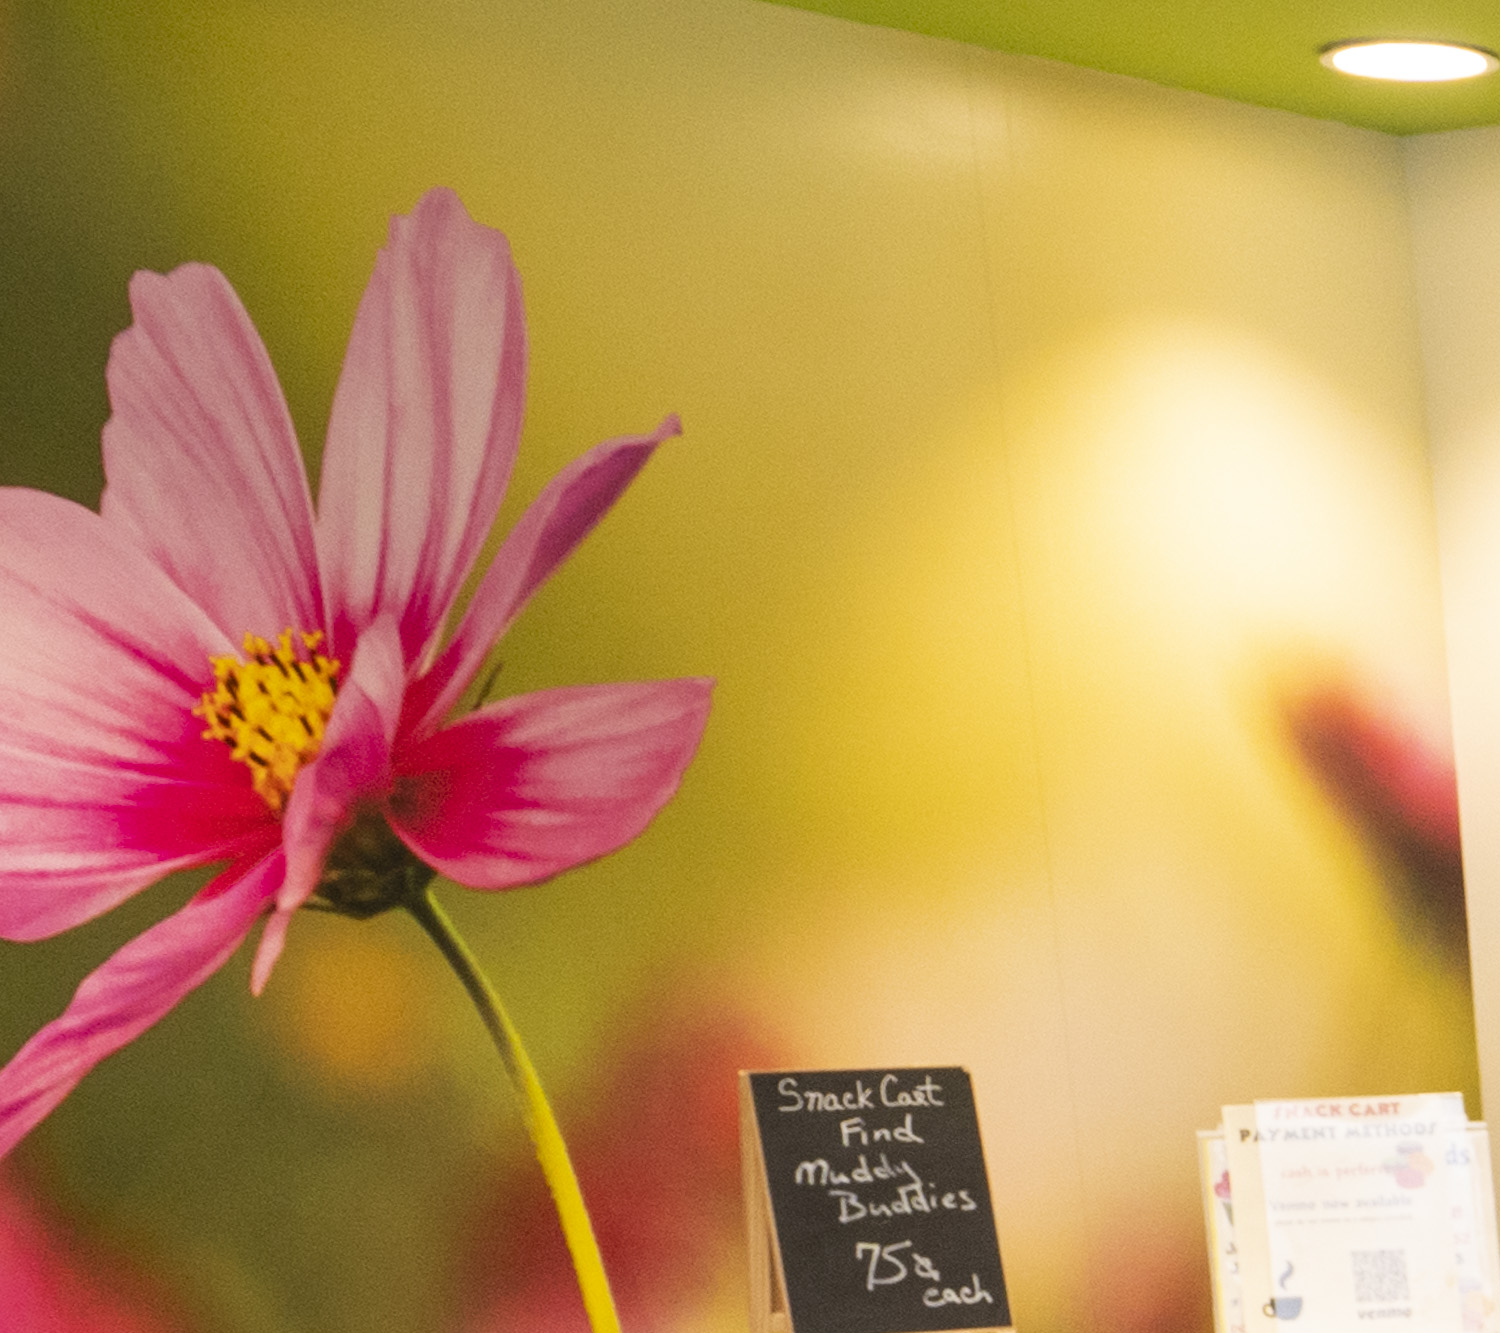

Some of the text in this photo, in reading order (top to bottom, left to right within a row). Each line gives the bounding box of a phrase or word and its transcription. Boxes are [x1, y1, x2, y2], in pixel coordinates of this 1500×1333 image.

[778, 1074, 945, 1112] Snack Cart
[1348, 1101, 1401, 1116] CART
[840, 1113, 925, 1147] Find
[1239, 1125, 1338, 1143] PAYMENT
[795, 1153, 922, 1189] Muddy
[828, 1182, 979, 1224] Buddies
[922, 1273, 994, 1307] each
